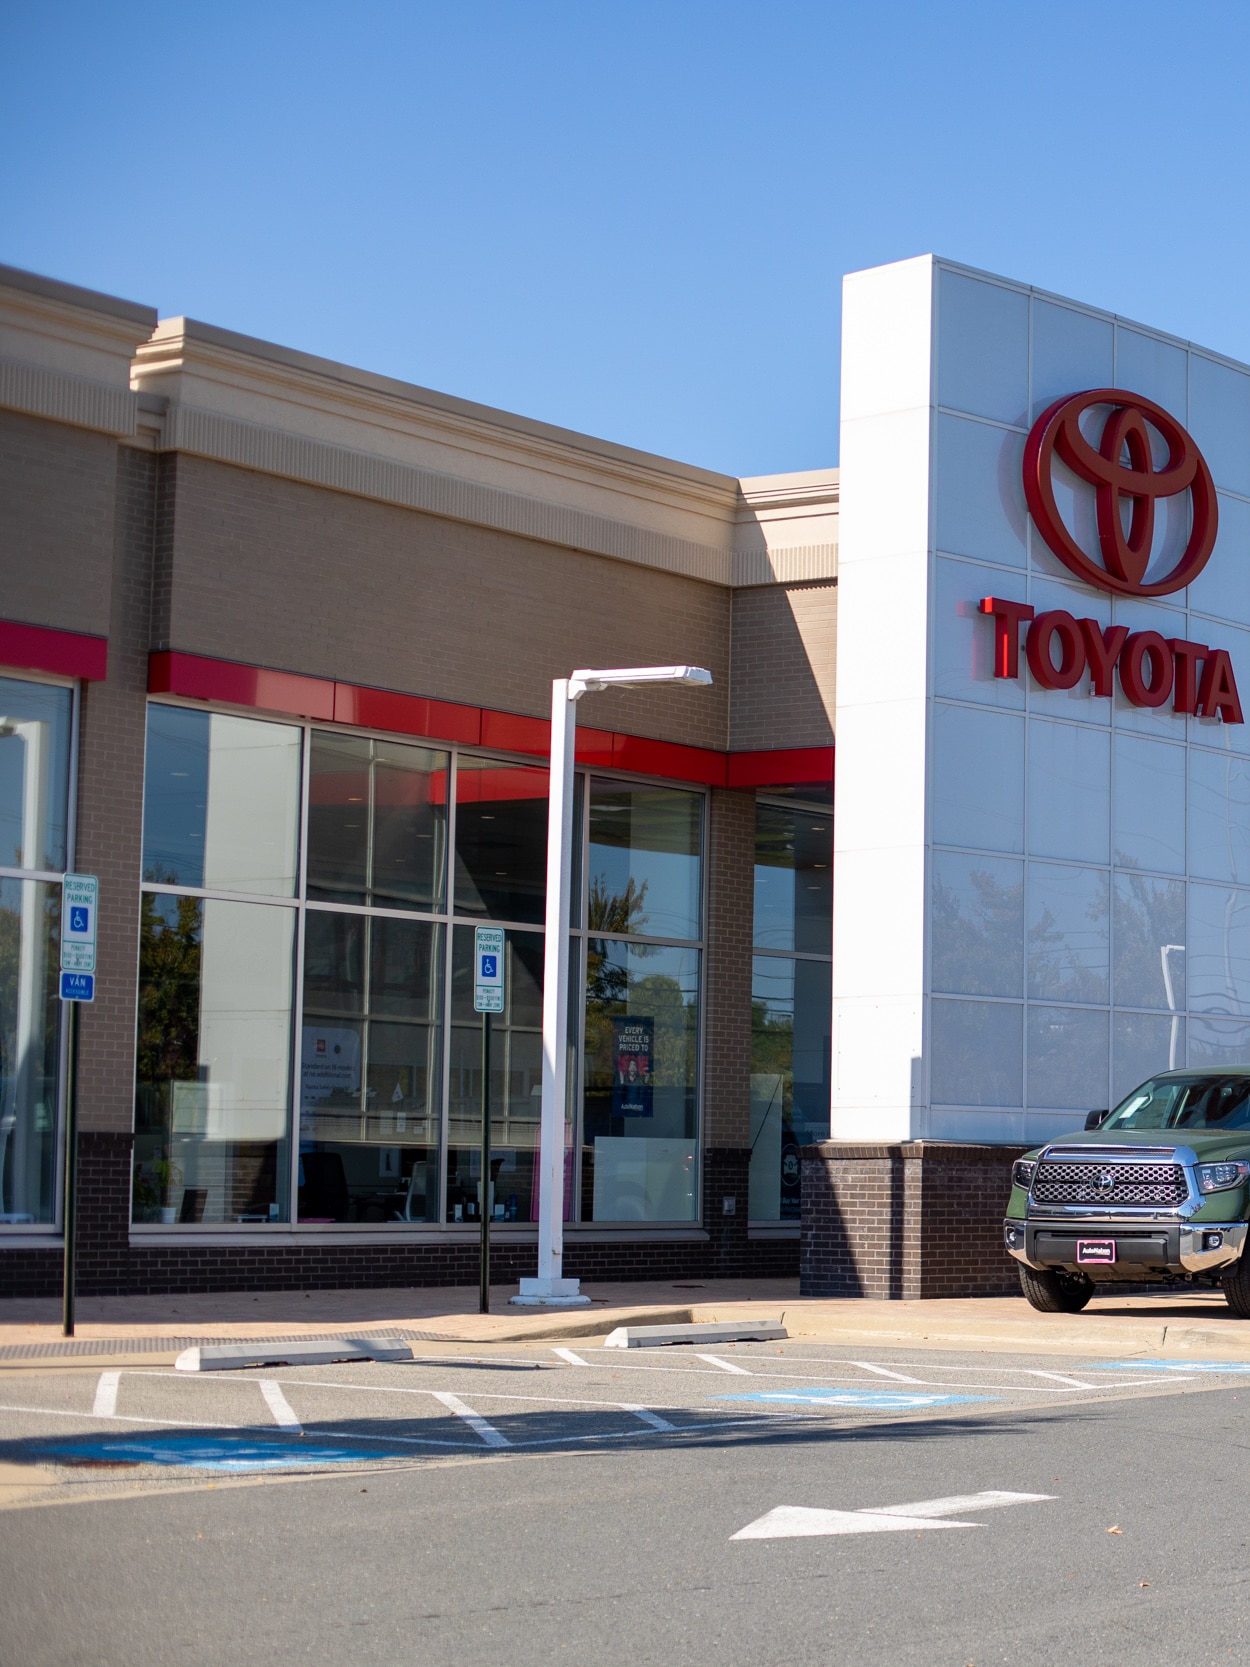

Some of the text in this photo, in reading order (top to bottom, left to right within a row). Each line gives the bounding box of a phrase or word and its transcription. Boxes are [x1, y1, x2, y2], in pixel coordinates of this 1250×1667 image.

[980, 597, 1244, 724] TOYOTA
[65, 880, 95, 893] RESERVED
[66, 893, 93, 904] PARKING
[477, 932, 502, 943] RESERVED
[478, 944, 500, 953] PARKING
[69, 977, 86, 988] VAN
[624, 1026, 643, 1034] EVERY
[618, 1035, 649, 1043] VEHICLE IS
[619, 1043, 648, 1052] PRICED TO
